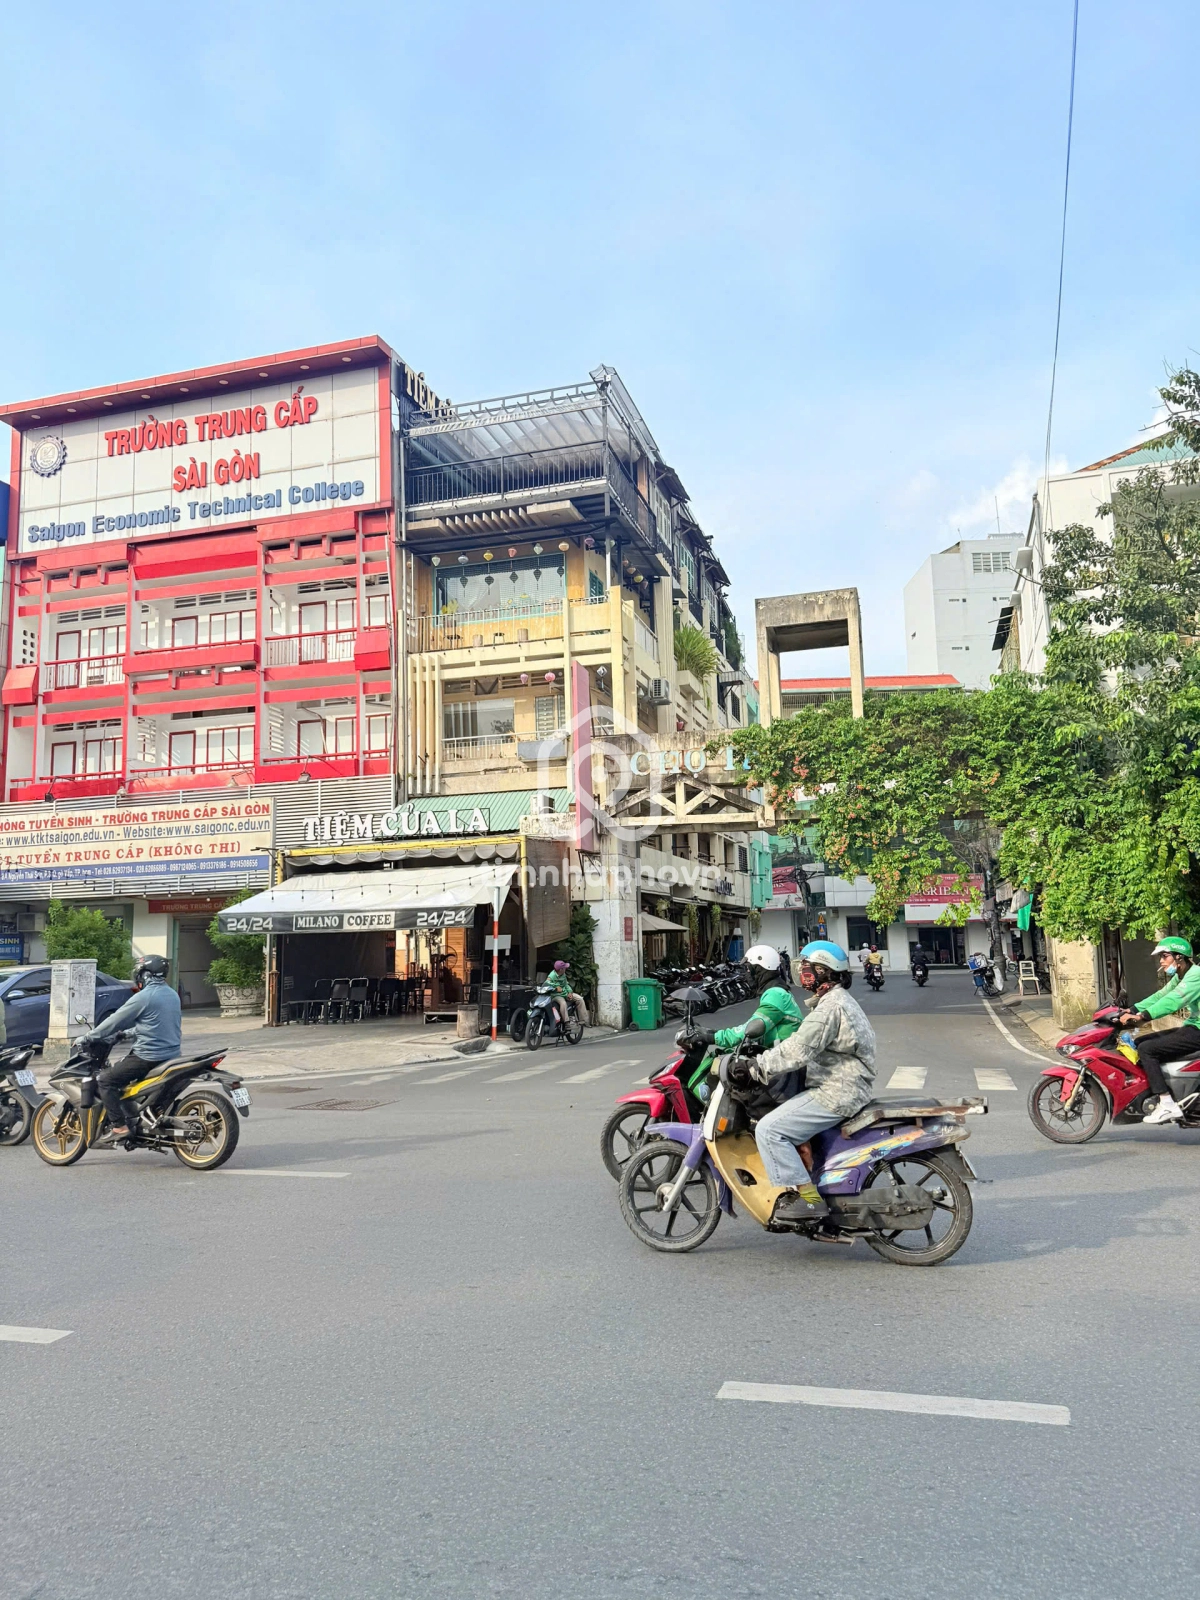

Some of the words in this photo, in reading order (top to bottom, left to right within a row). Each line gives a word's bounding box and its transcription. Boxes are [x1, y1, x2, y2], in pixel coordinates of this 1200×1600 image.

[104, 414, 187, 457] TRƯỜNG
[195, 405, 267, 441] TRUNG
[274, 386, 318, 428] CẤP
[172, 457, 208, 493] SÀI
[214, 449, 260, 486] GÒN
[27, 521, 86, 544] Saigon
[92, 505, 181, 533] Economic
[188, 489, 282, 520] Technical
[288, 479, 364, 506] College
[630, 745, 706, 779] CHỢ
[29, 813, 64, 830] TUYỂN
[67, 816, 92, 827] SINH
[103, 810, 148, 825] TRƯỜNG
[152, 809, 190, 821] TRUNG
[194, 803, 217, 818] CẤP
[221, 804, 241, 816] SÀI
[245, 801, 270, 815] GÒN
[303, 810, 373, 846] TIỆM
[380, 803, 442, 837] CỦA
[448, 808, 489, 834] LA
[6, 829, 115, 846] www.ktktsaigon.edu.vn
[17, 848, 60, 864] TUYỂN
[66, 850, 110, 862] TRUNG
[116, 843, 144, 859] CẤP
[149, 843, 203, 858] (KHÔNG
[209, 841, 241, 854] THI)
[227, 917, 274, 932] 24/24
[297, 914, 340, 929] MILANO
[347, 912, 392, 927] COFFEE
[416, 908, 466, 926] 24/24
